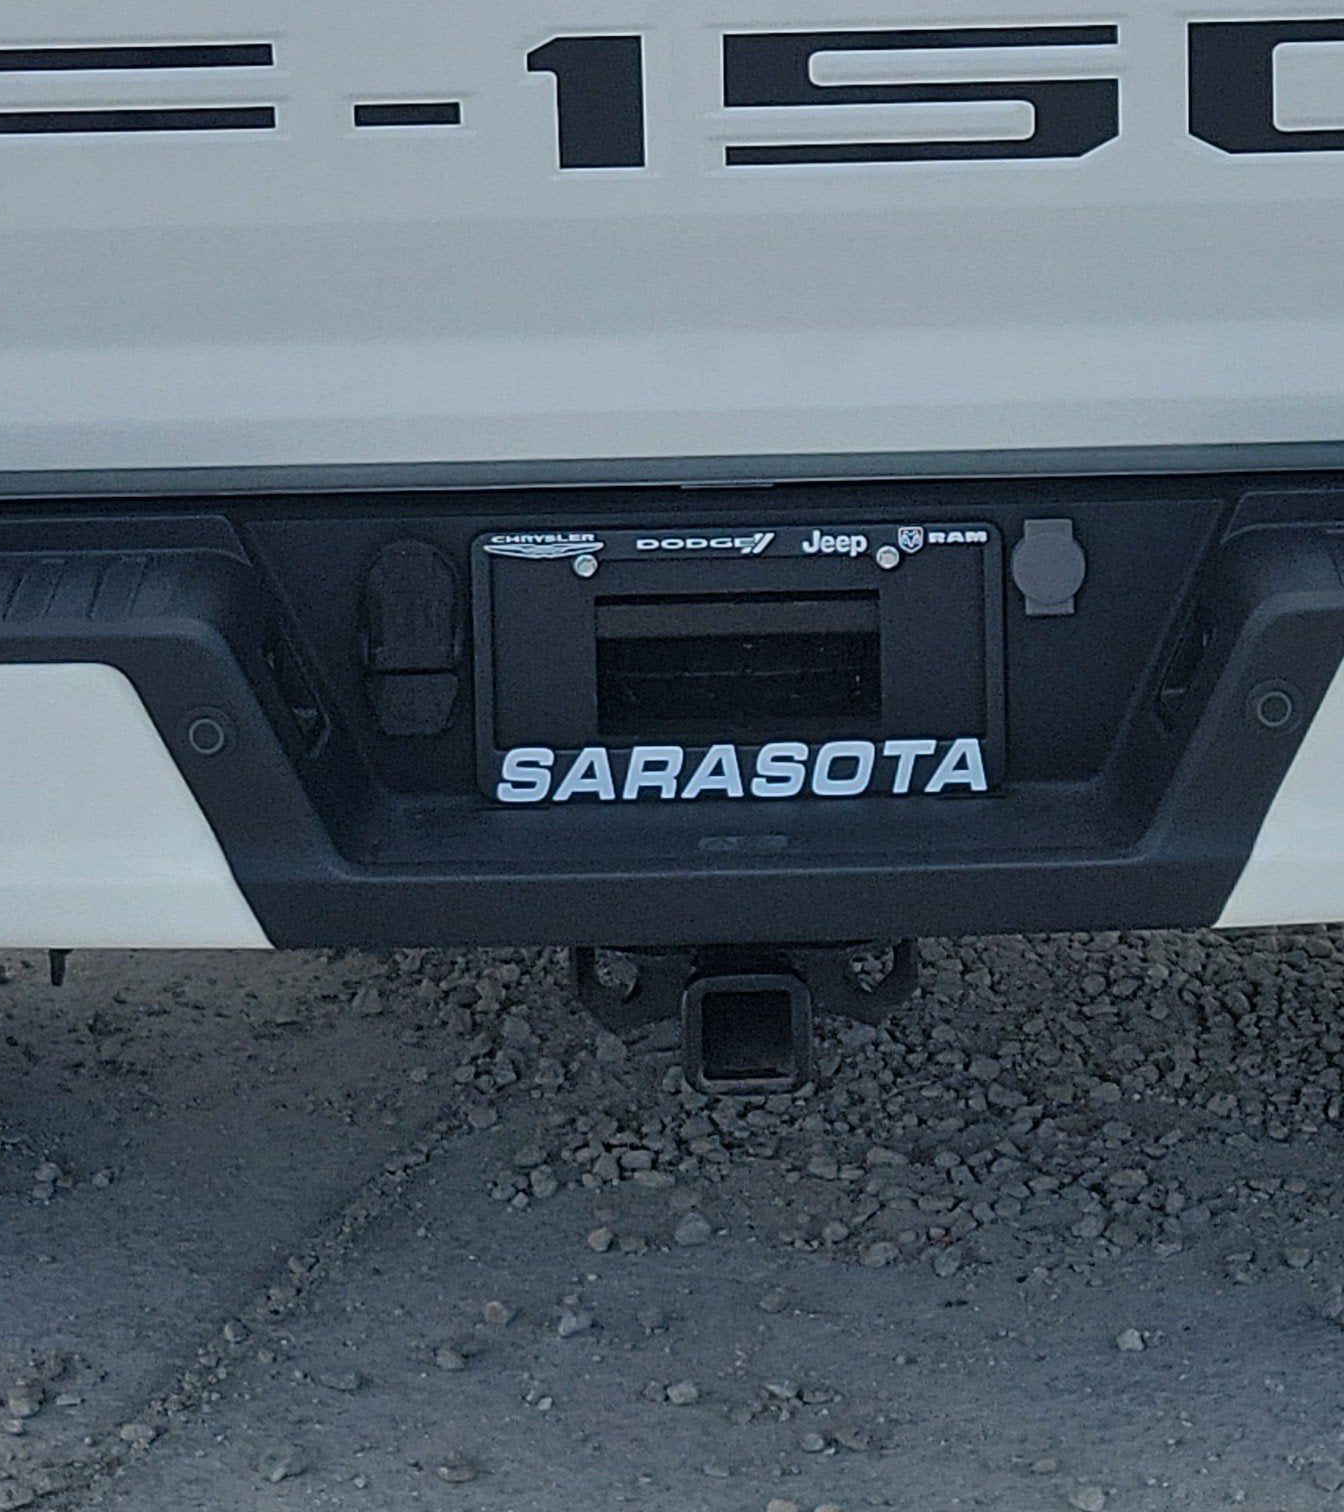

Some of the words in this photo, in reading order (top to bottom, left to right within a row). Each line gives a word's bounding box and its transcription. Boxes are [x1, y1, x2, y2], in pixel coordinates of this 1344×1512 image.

[491, 533, 596, 543] CHRYSLER
[636, 537, 759, 550] DODGE
[802, 530, 868, 556] Jeep
[928, 530, 988, 544] RAM
[497, 738, 988, 803] SARASOTA
